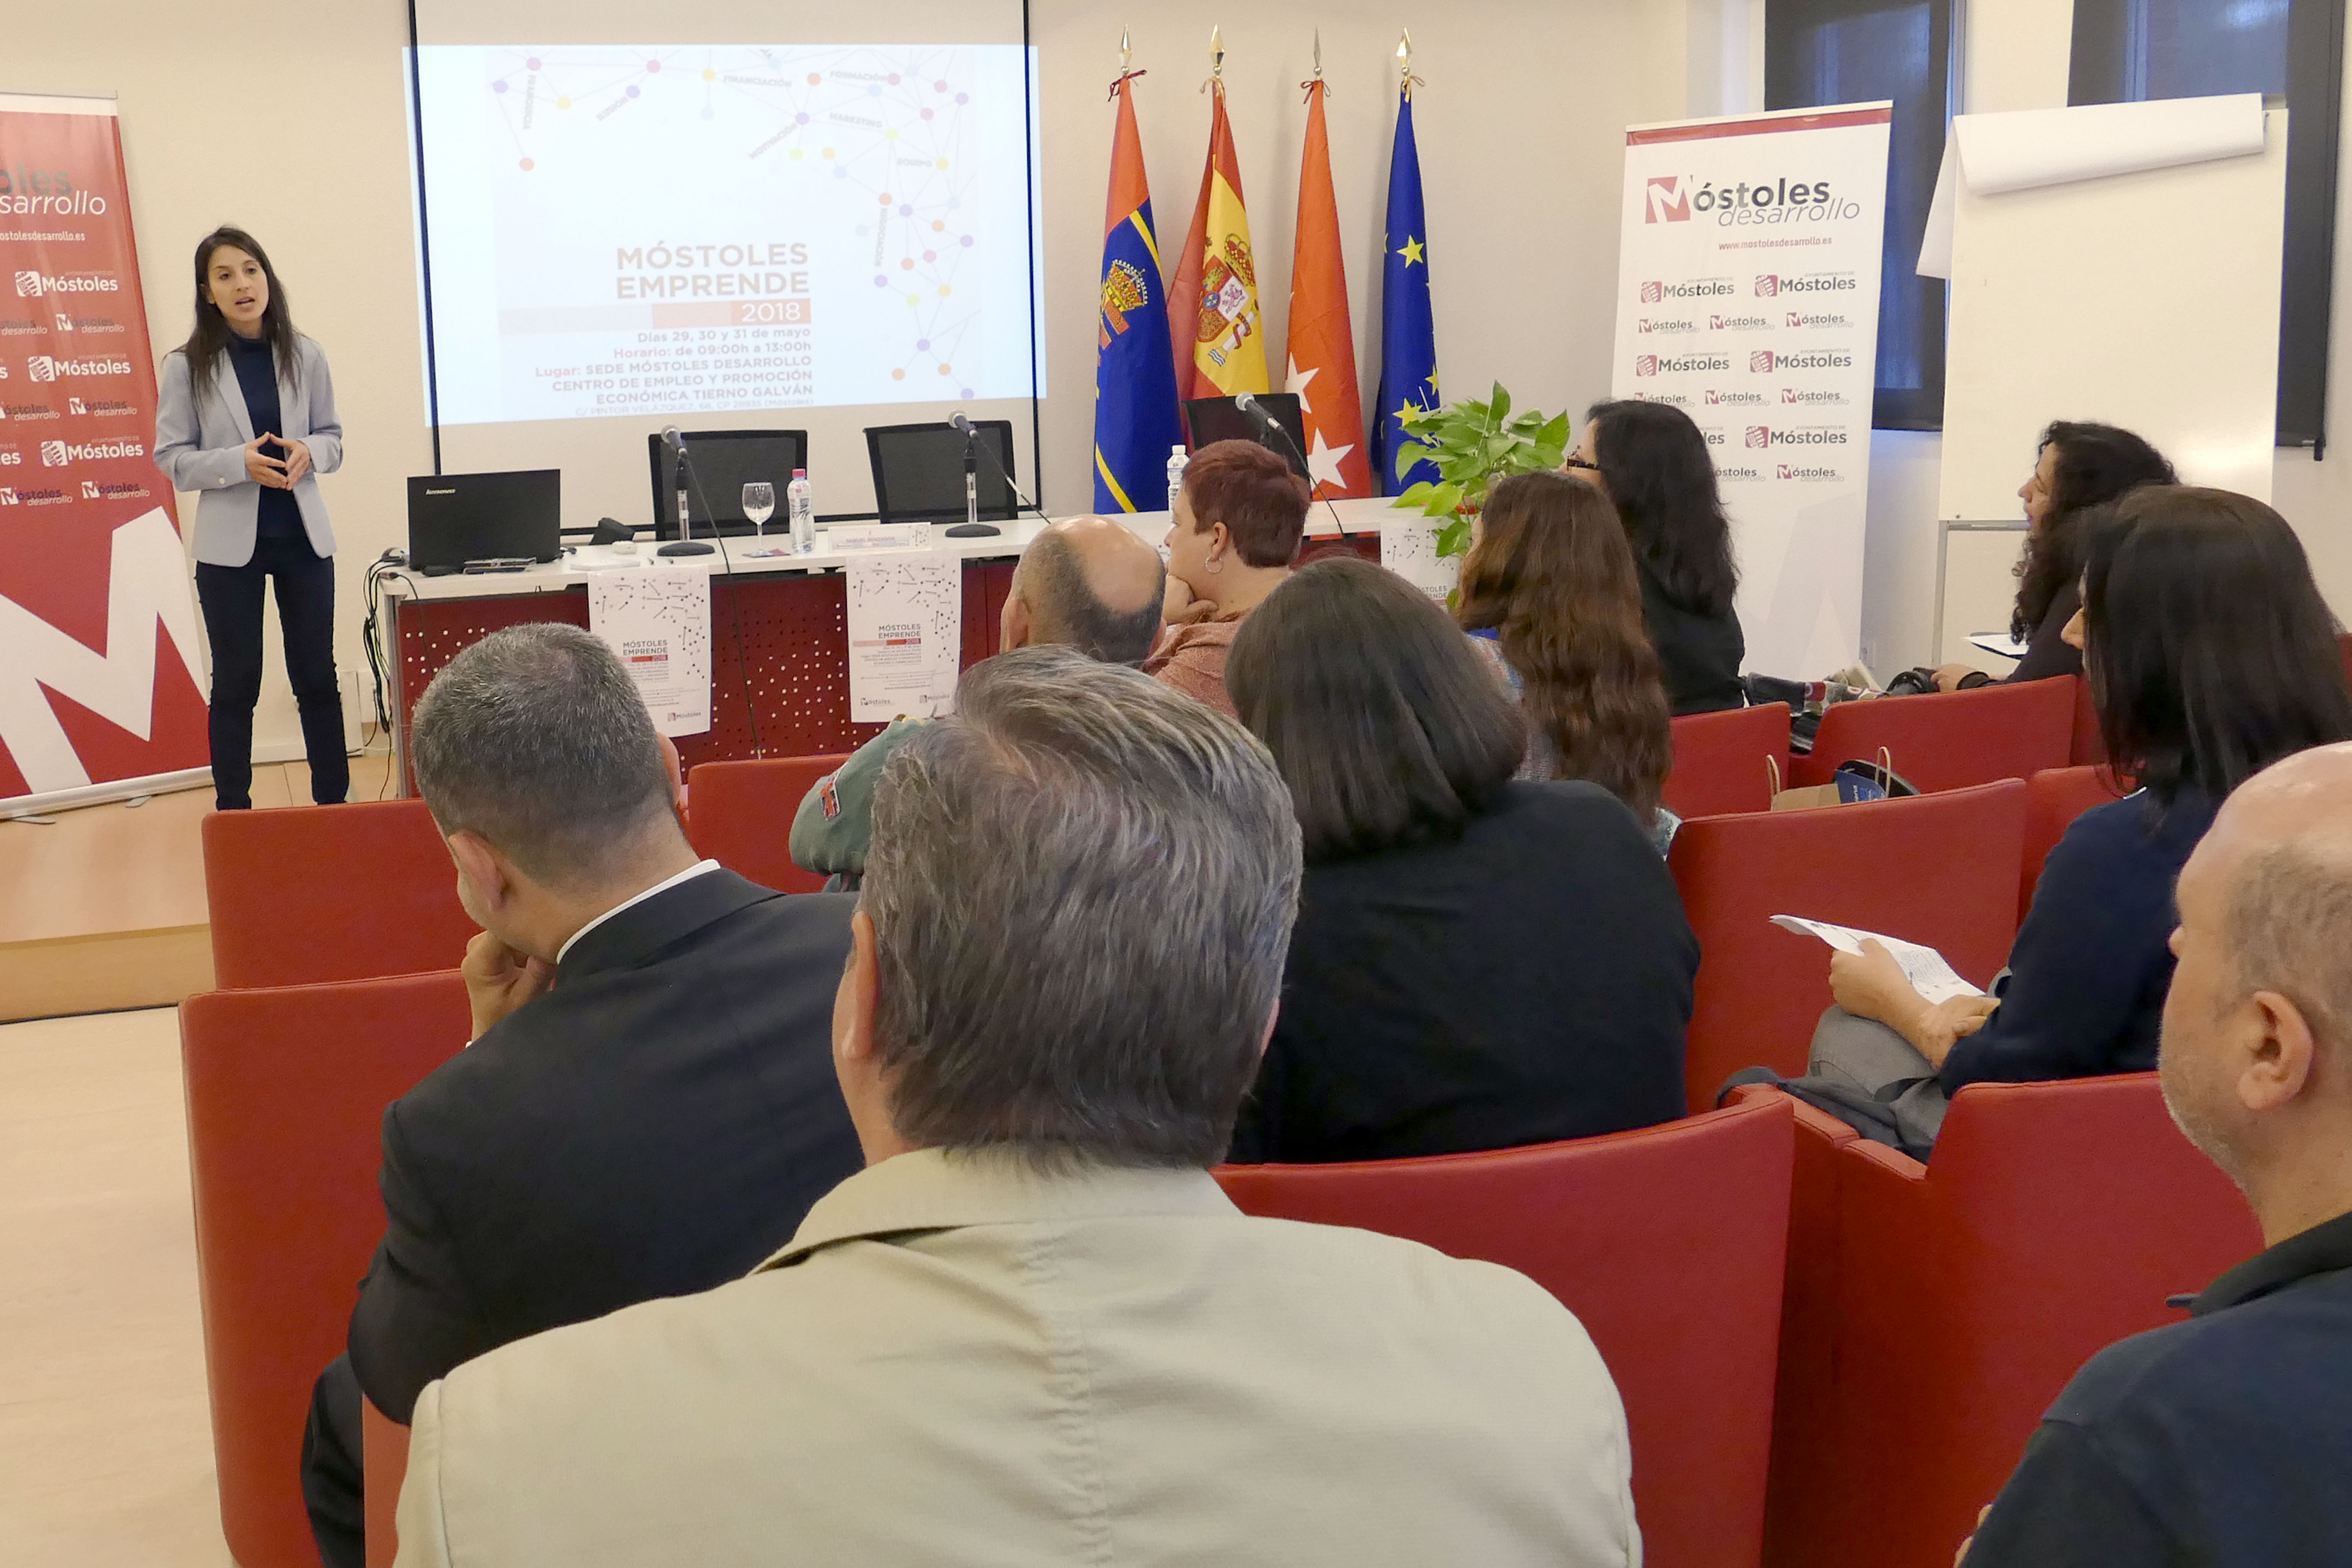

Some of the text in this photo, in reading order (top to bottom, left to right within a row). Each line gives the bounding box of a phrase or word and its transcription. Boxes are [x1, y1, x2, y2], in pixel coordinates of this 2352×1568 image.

[1718, 198, 1860, 227] desarrollo
[1718, 236, 1832, 251] www.mostolesdesarrollo.es
[617, 240, 808, 270] MÓSTOLES
[42, 276, 119, 292] Móstoles
[617, 271, 809, 299] EMPRENDE
[1663, 282, 1735, 297] Móstoles
[1779, 276, 1856, 292] Móstoles
[741, 302, 801, 323] 2018
[81, 325, 125, 334] desarrollo
[638, 328, 811, 343] Días 29, 30 y 31 de mayo
[614, 347, 671, 358] Horario:
[675, 346, 692, 356] de
[698, 343, 748, 355] 09:00h
[765, 341, 811, 352] 13:00h
[55, 359, 131, 377] Móstoles
[535, 356, 812, 378] Lugar: SEDE MÓSTOLES DESARROLLO
[1659, 357, 1730, 371] Móstoles
[1775, 354, 1852, 368] Móstoles
[552, 369, 812, 392] CENTRO DE EMPLEO Y PROMOCIÓN
[597, 383, 813, 404] ECONÓMICA TIERNO GALVÁN
[14, 410, 60, 421] desarrollo
[94, 406, 137, 417] desarrollo
[1770, 430, 1847, 444] Móstoles
[67, 441, 144, 460] Móstoles
[1715, 467, 1757, 477] óstoles
[27, 495, 73, 506] desarrollo
[107, 488, 150, 500] desarrollo
[878, 631, 921, 639] EMPRENDE
[879, 623, 921, 632] MÓSTOLES
[623, 639, 668, 648] MÓSTOLES
[623, 646, 668, 655] EMPRENDE
